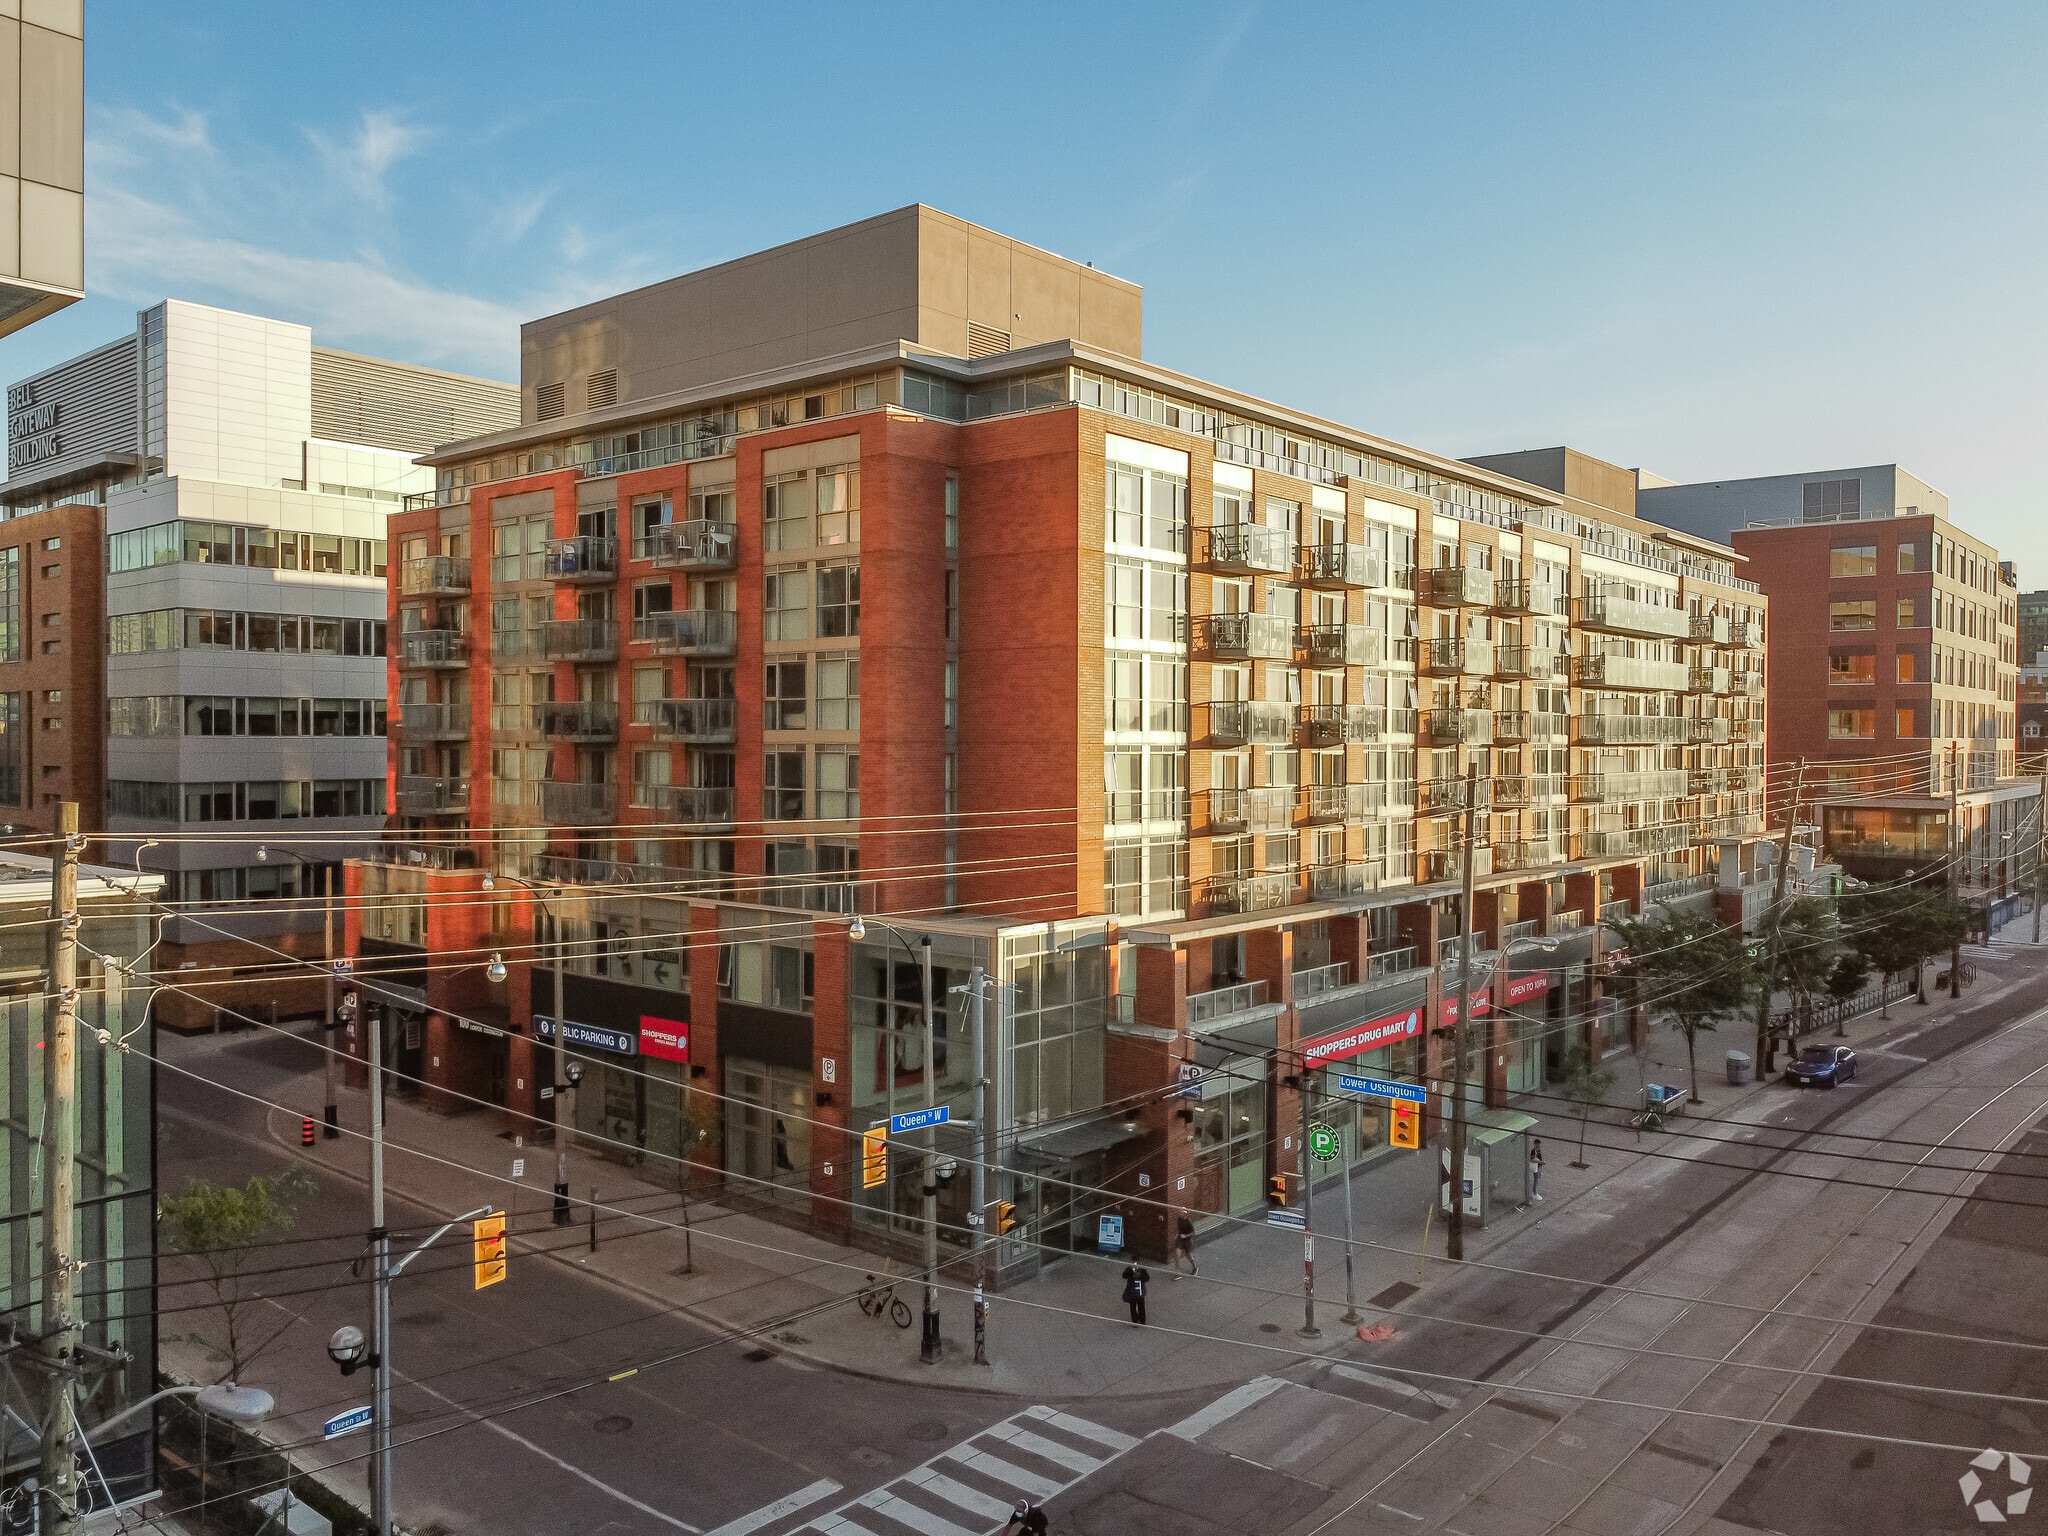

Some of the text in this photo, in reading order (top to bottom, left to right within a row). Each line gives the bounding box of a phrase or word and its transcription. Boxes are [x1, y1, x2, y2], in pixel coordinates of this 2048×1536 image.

[9, 384, 32, 411] BELL
[11, 403, 56, 439] GATEWAY
[9, 434, 57, 468] BUILDING
[1510, 986, 1526, 997] OPEN
[1526, 981, 1534, 992] TO
[552, 1024, 579, 1040] PBLIC
[580, 1030, 615, 1046] PARKING
[641, 1029, 677, 1042] SHOPPERS
[1306, 1020, 1406, 1060] SHOPPERS DRUG MART
[1341, 1076, 1367, 1089] Lower
[1370, 1080, 1416, 1098] Ossington
[899, 1113, 927, 1128] Queen
[934, 1109, 942, 1121] W
[1316, 1133, 1330, 1148] P
[331, 1418, 354, 1431] Queen
[362, 1410, 369, 1420] W
